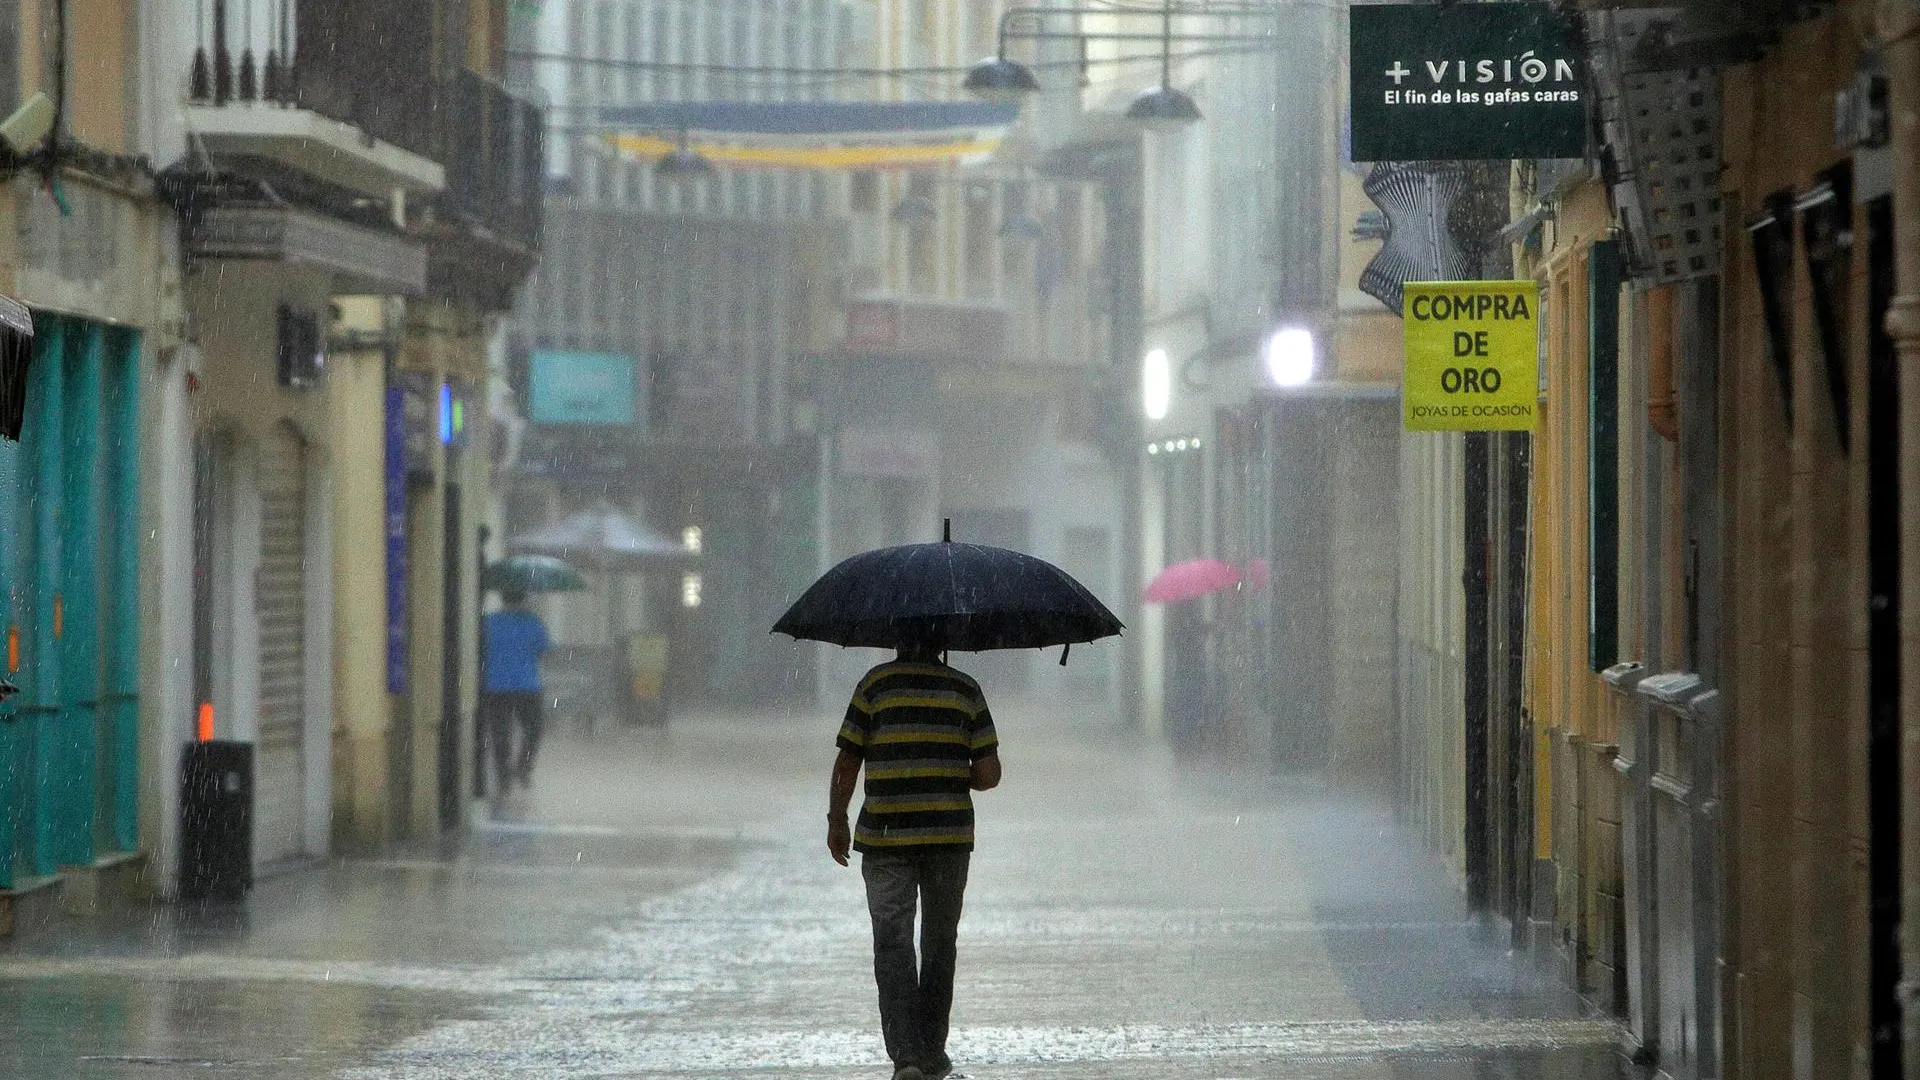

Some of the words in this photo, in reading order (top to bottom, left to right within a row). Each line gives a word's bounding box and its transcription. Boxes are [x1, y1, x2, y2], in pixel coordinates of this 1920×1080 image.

[1384, 90, 1400, 104] El
[1405, 89, 1427, 104] fin
[1431, 89, 1452, 104] de
[1456, 89, 1480, 103] las
[1484, 88, 1530, 106] gafas
[1534, 89, 1579, 102] caras
[1412, 294, 1531, 321] COMPRA
[1453, 331, 1489, 357] DE
[1441, 367, 1502, 394] ORO
[1412, 405, 1448, 419] JOYAS
[1451, 405, 1469, 417] DE
[1472, 403, 1532, 417] OCASIÓN
